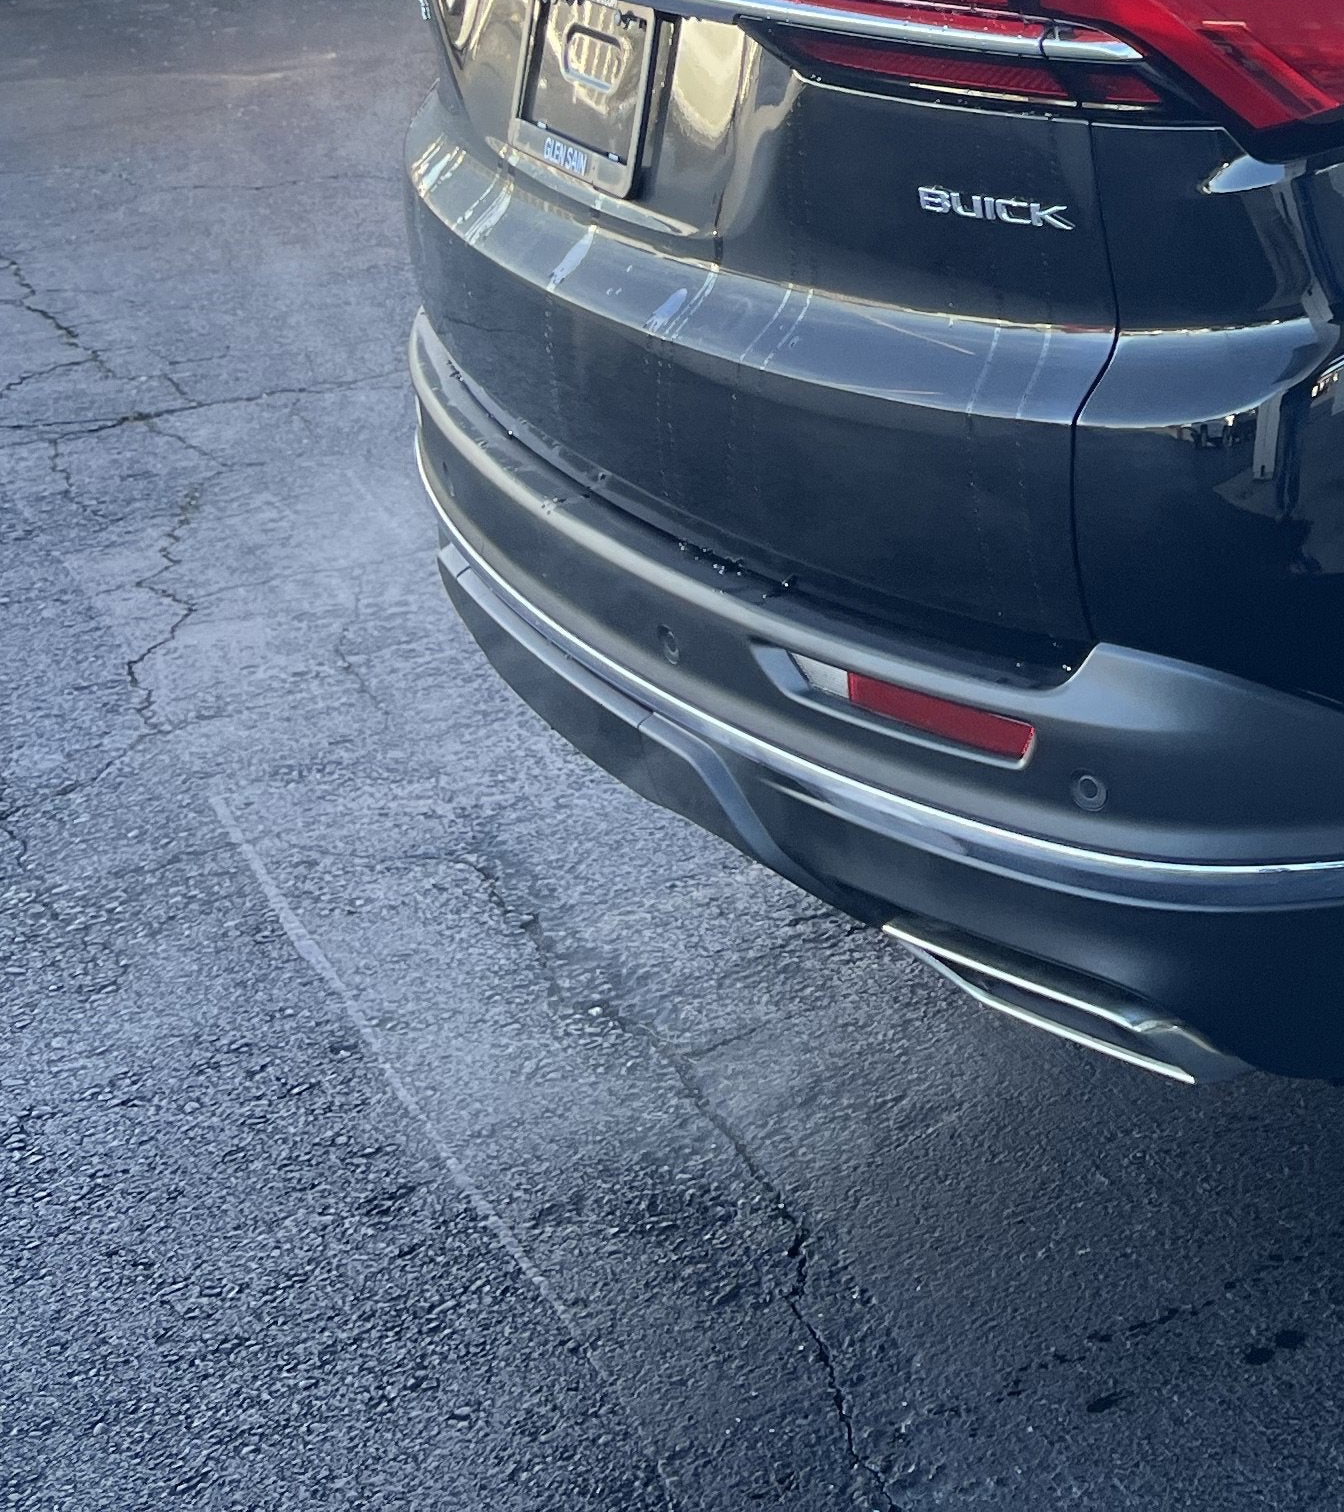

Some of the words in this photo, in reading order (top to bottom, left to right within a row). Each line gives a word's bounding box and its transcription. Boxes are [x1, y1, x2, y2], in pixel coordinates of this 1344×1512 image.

[544, 137, 567, 167] GLEN
[564, 147, 588, 177] SAIN
[917, 186, 1075, 230] BUICK
